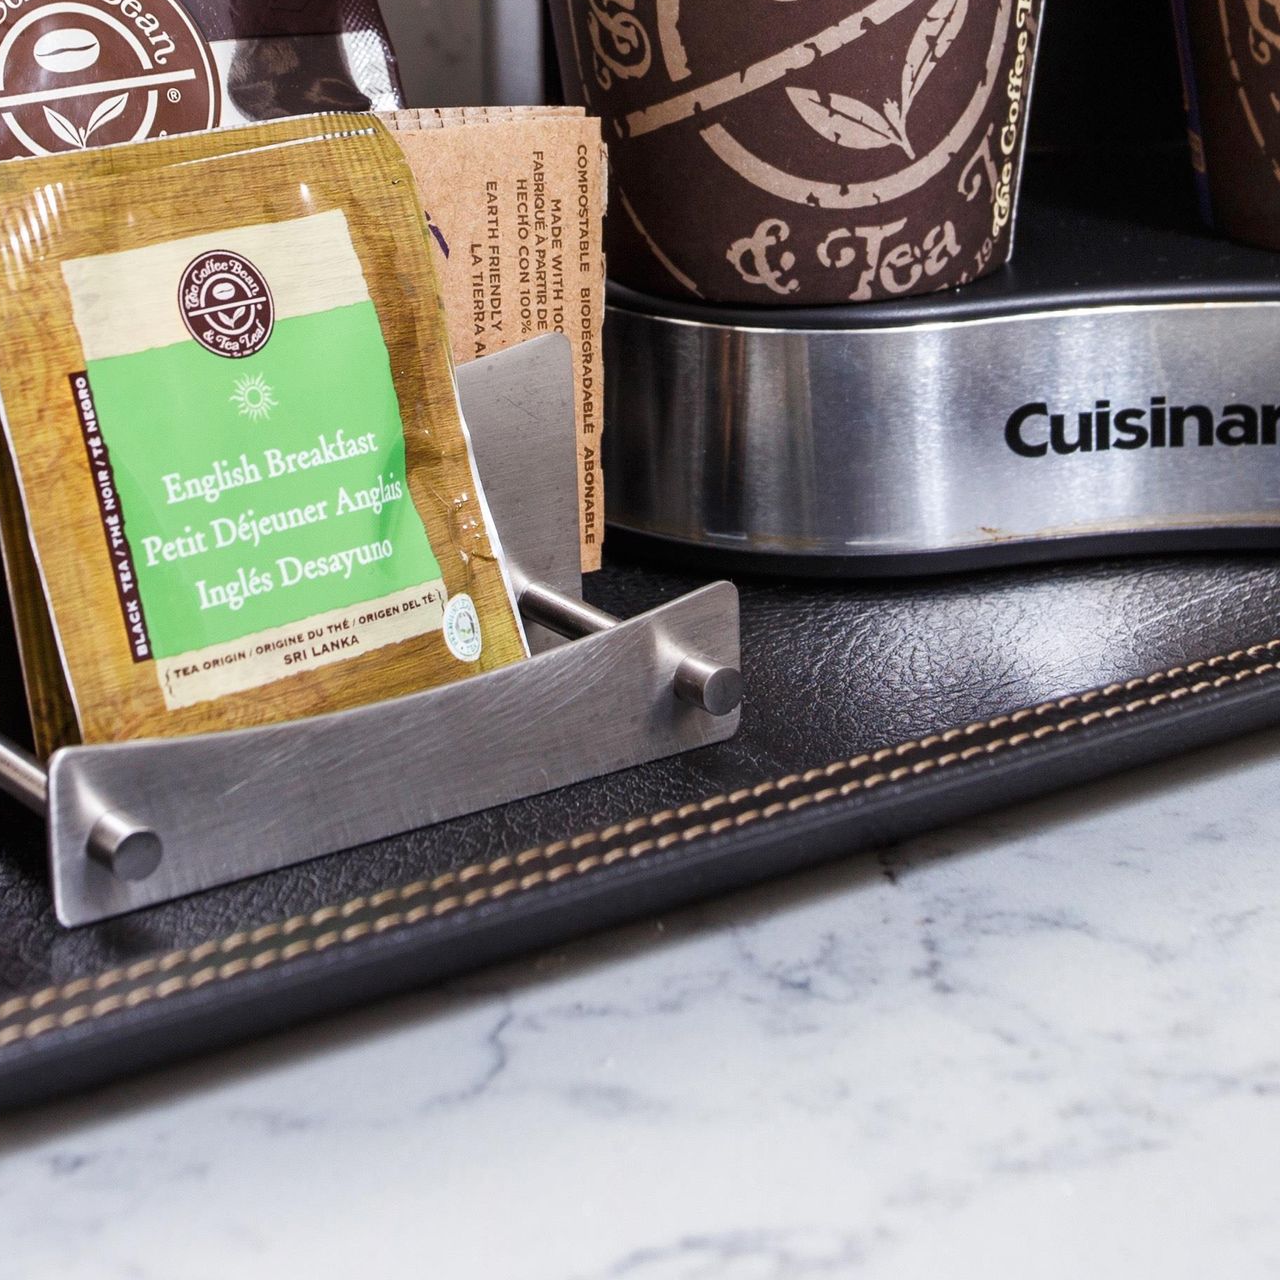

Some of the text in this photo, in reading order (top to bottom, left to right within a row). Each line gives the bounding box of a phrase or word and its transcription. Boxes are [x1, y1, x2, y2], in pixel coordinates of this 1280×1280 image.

[1000, 29, 1028, 156] Coffee
[516, 178, 529, 241] HECHO
[576, 143, 591, 273] COMPOSTABLE
[992, 160, 1013, 238] The
[191, 258, 229, 285] Coffee
[228, 259, 260, 296] Bean
[470, 243, 483, 267] LA
[486, 180, 503, 332] EARTH FRIENDLY
[518, 245, 530, 284] CON
[535, 248, 548, 306] PARTIR
[550, 198, 564, 334] MADE WITH 100
[726, 216, 962, 301] & Tea
[472, 271, 486, 336] TIERRA
[519, 288, 532, 334] 100%
[536, 308, 548, 330] DE
[202, 318, 266, 351] & Tea Leaf
[75, 376, 98, 433] NEGRO
[87, 435, 104, 459] TÉ
[161, 428, 379, 505] English Breakfast
[98, 469, 116, 511] NOIR
[141, 471, 403, 568] Petit Déjeuner Anglais
[583, 446, 596, 545] ABONABLE
[105, 514, 125, 549] THÉ
[118, 559, 134, 594] TEA
[195, 538, 394, 611] Inglés Desayuno
[126, 599, 149, 658] BLACK
[173, 664, 201, 680] TEA
[202, 650, 247, 671] ORIGIN
[254, 633, 305, 656] ORIGINE
[307, 627, 324, 640] DU
[326, 617, 351, 634] THÉ
[358, 605, 400, 625] ORIGEN
[402, 599, 421, 612] DEL
[283, 634, 360, 666] SRI LANKA
